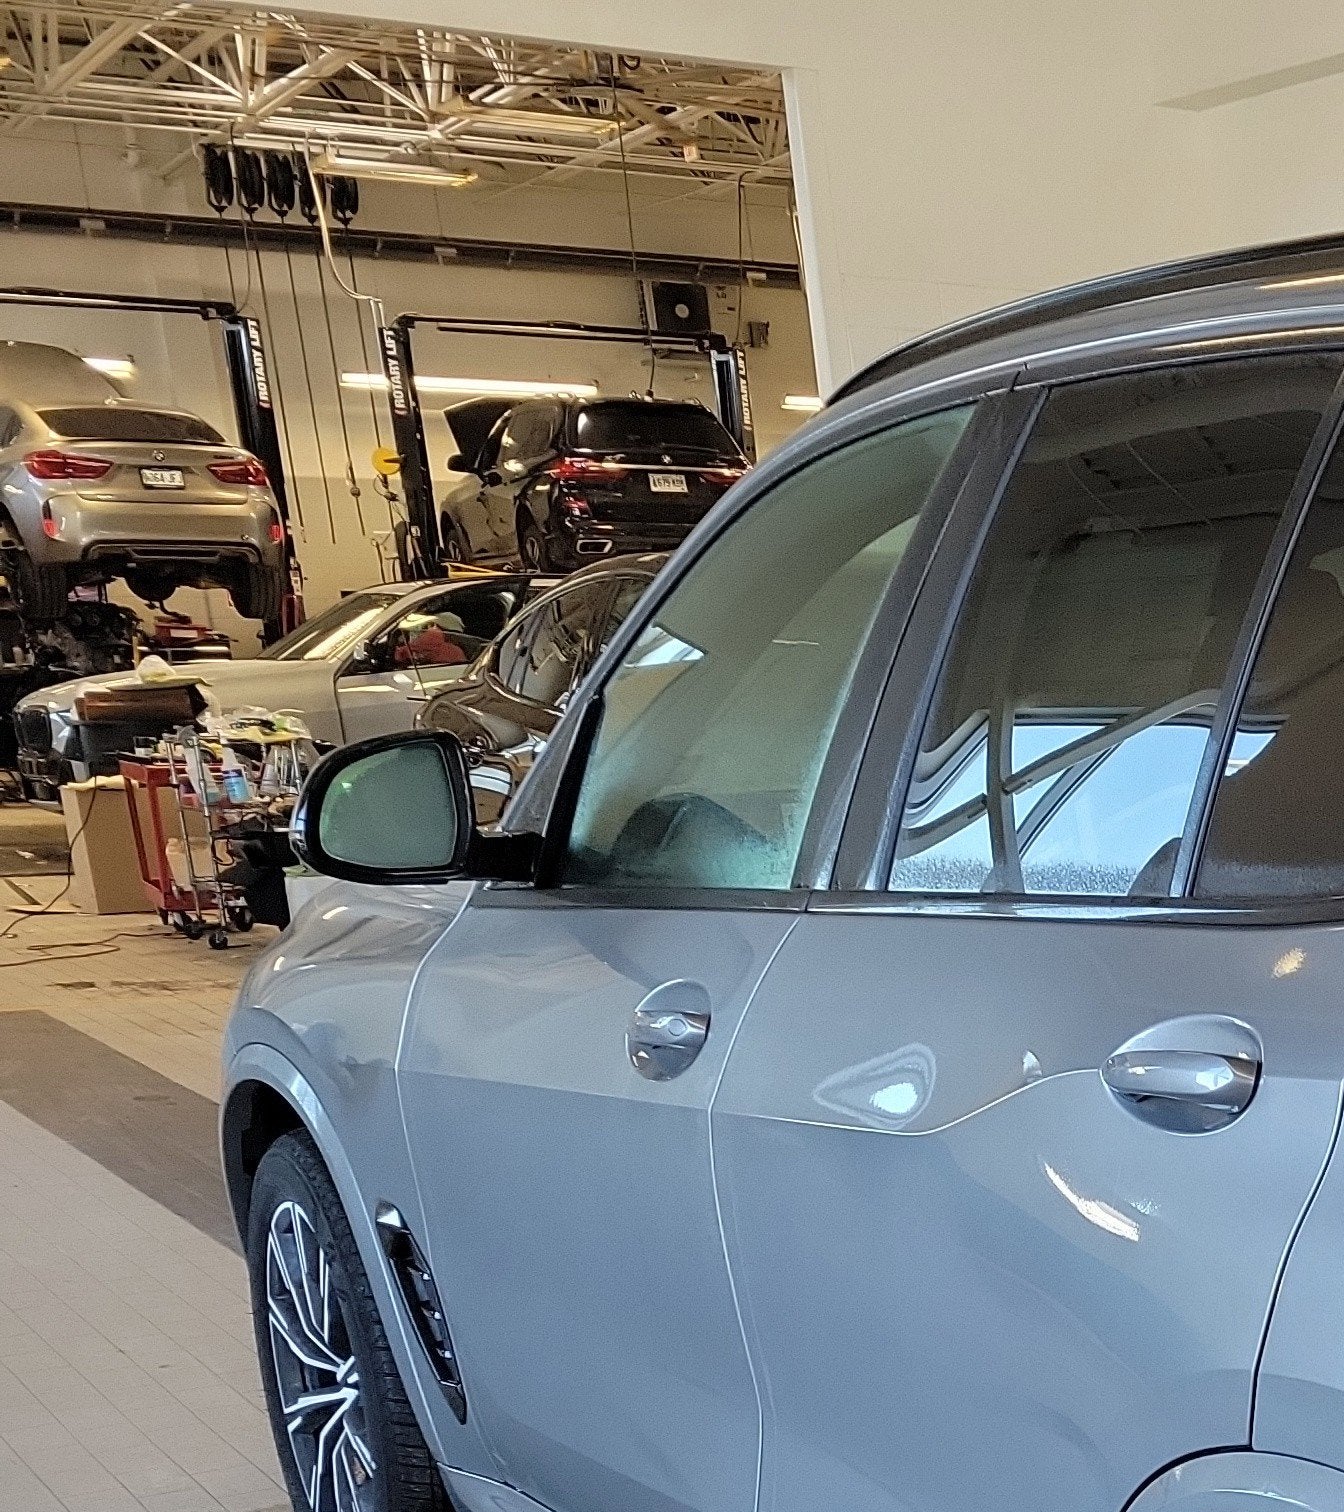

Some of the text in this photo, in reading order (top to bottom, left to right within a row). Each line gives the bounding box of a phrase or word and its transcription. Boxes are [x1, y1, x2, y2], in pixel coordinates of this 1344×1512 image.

[247, 319, 270, 401] ROTARY LIFT
[382, 328, 407, 408] ROTARY LIFT
